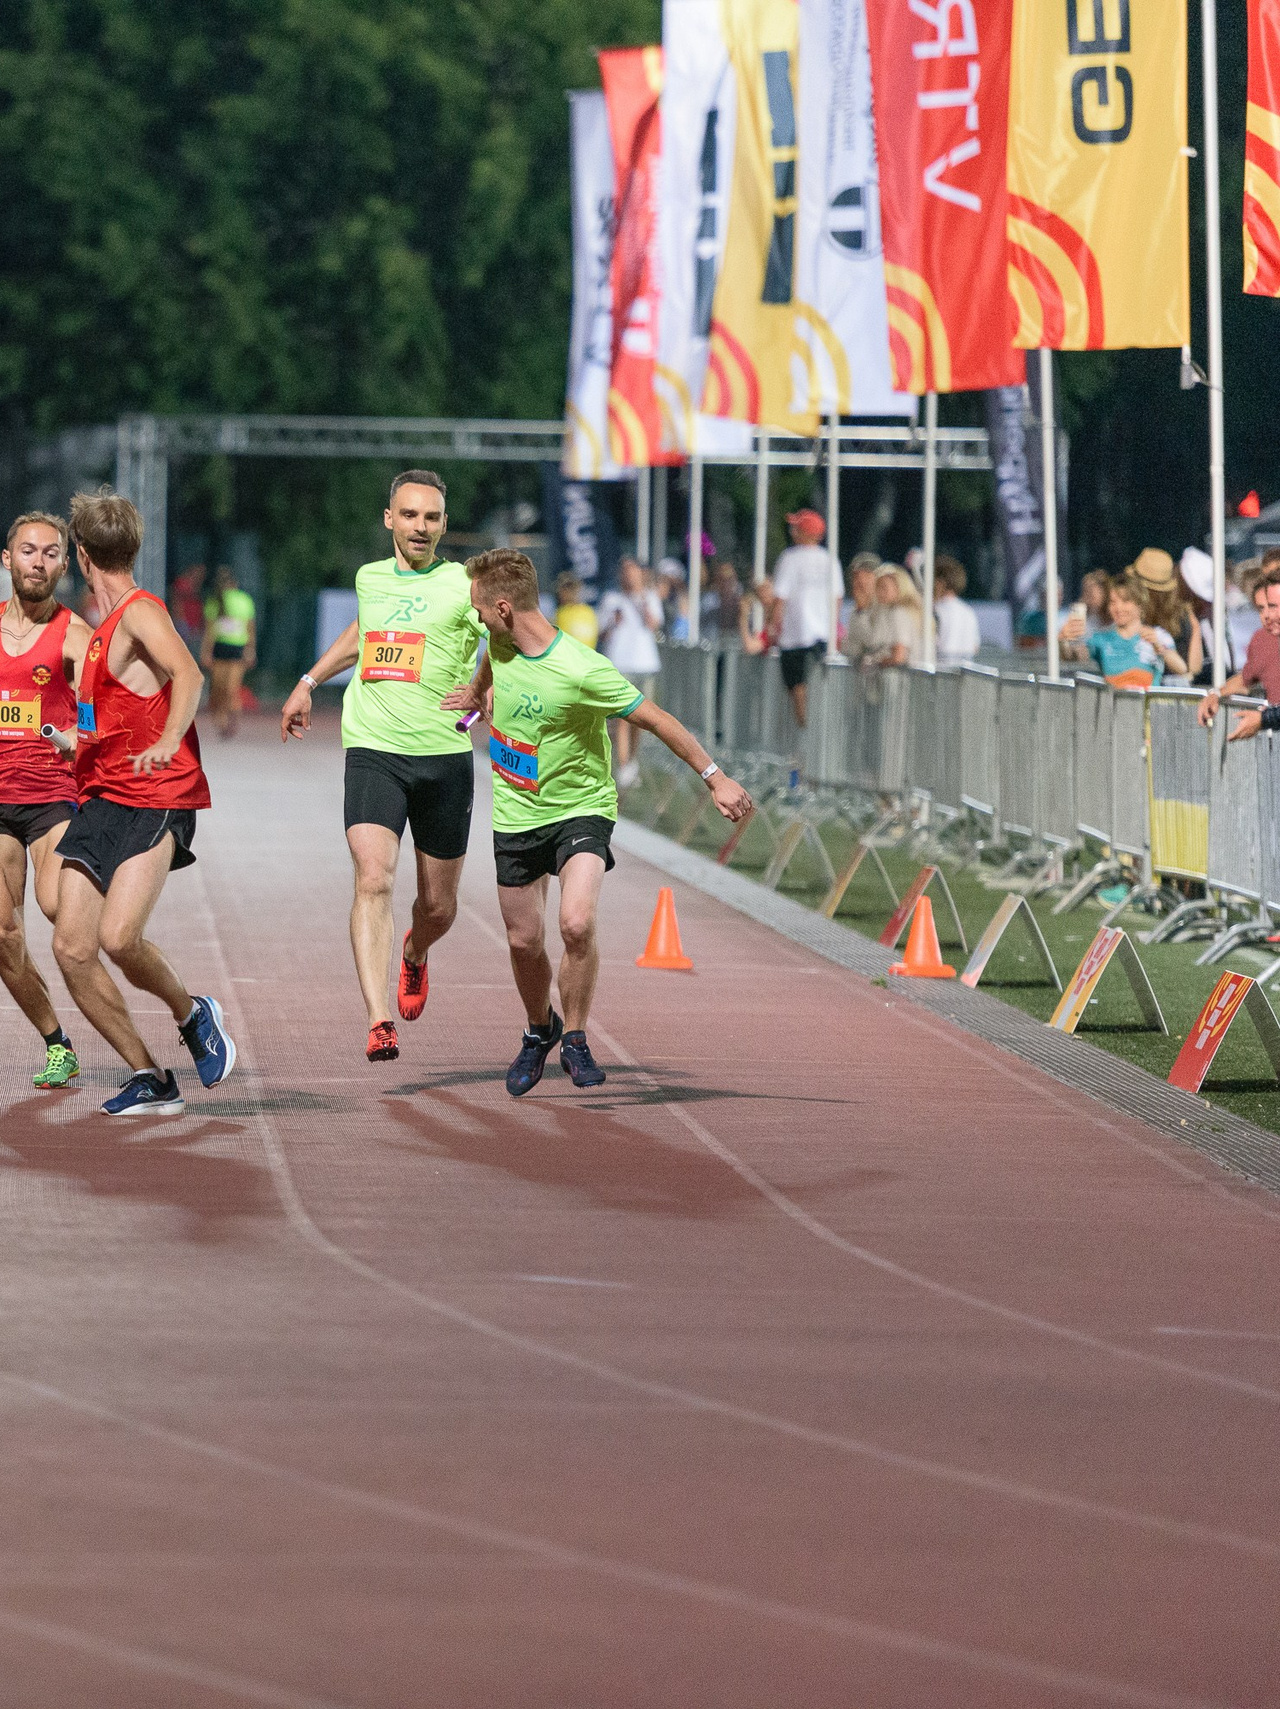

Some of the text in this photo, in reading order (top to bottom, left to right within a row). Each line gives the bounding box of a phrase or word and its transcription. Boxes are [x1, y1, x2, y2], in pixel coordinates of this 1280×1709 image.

[375, 646, 415, 666] 307 2
[27, 713, 33, 723] 2
[500, 747, 532, 775] 307 3
